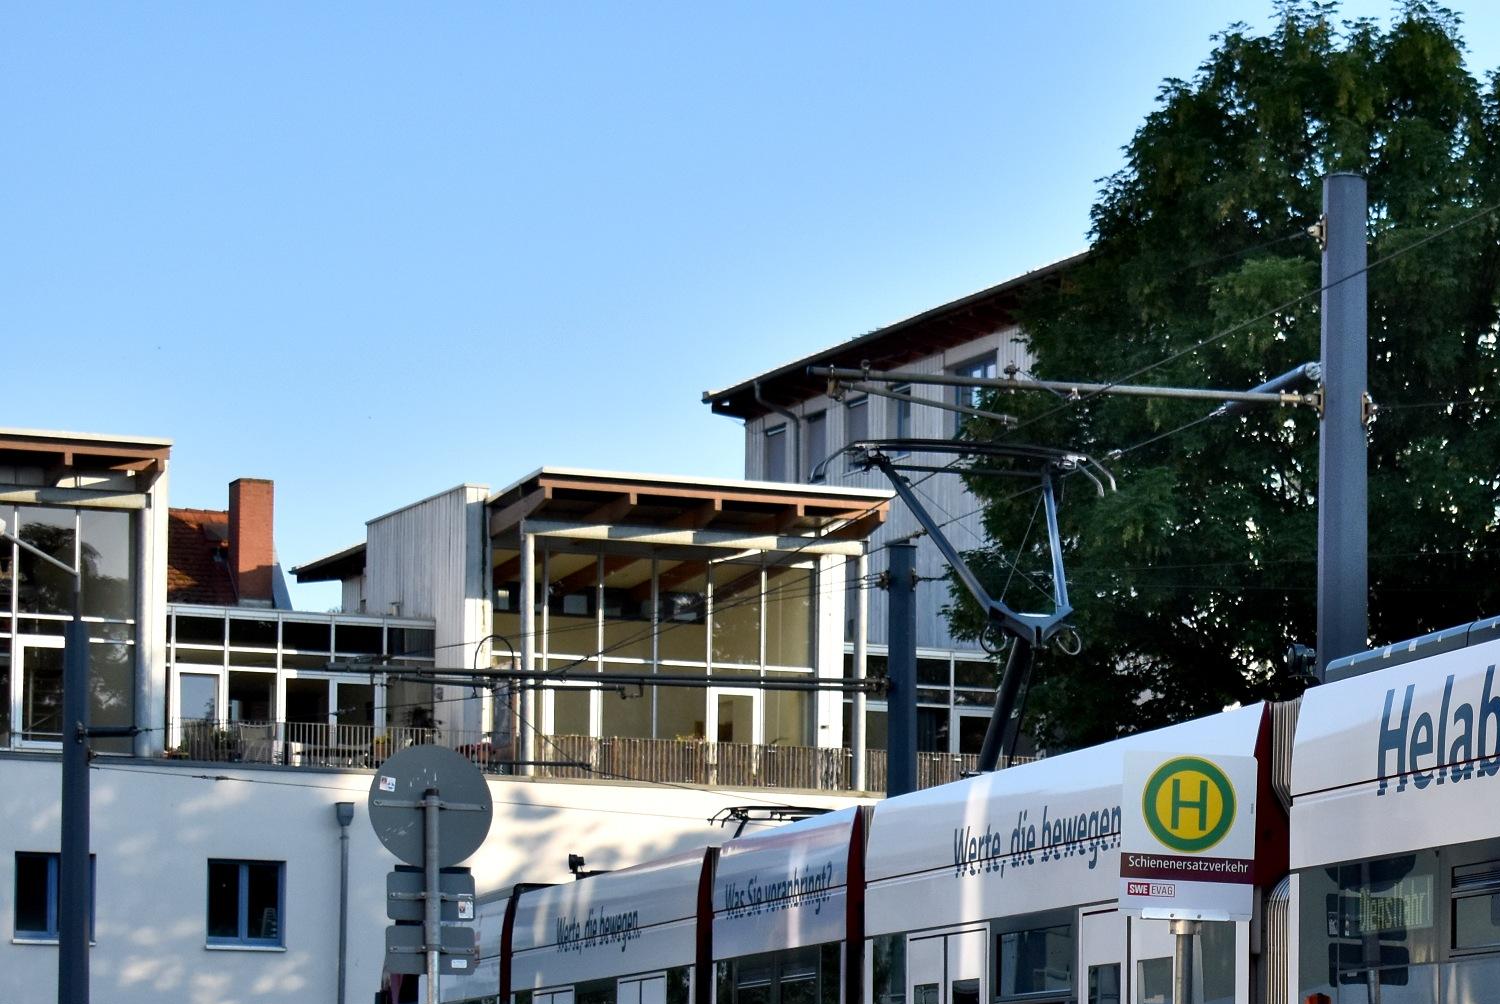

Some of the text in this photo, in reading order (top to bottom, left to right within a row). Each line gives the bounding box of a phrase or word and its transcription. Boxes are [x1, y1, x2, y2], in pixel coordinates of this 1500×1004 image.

[1171, 778, 1208, 831] H
[954, 824, 1006, 878] Werte,
[1010, 809, 1036, 868] die
[1128, 855, 1249, 873] Schienenersatzverkehr
[726, 861, 832, 920] Was Sie voranbringt?
[1129, 885, 1173, 895] SWE EVAG
